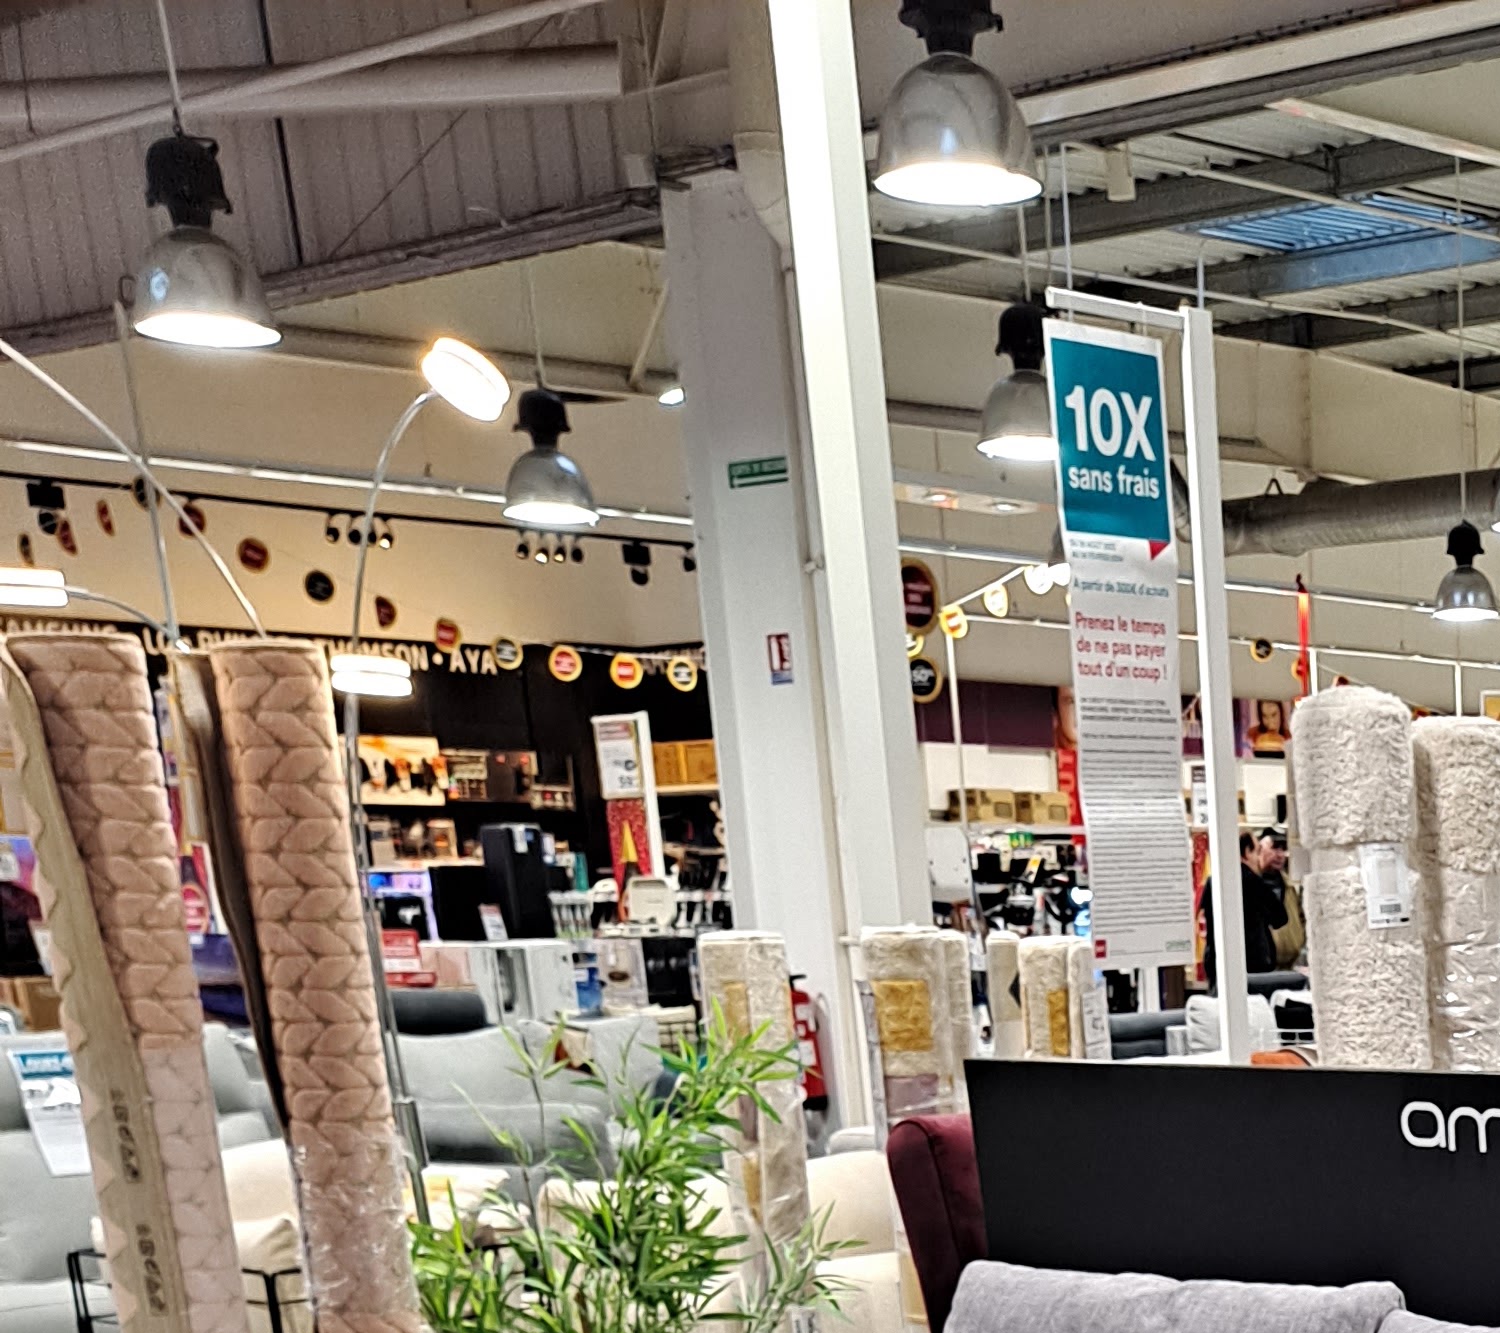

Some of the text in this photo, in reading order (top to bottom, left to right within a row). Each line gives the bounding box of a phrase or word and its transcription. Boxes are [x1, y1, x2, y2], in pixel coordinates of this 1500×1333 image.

[1064, 385, 1157, 462] 10X
[1068, 464, 1160, 500] sans frais
[1075, 611, 1167, 638] Prenez le temps
[1076, 635, 1166, 661] de ne pas payer
[1077, 660, 1103, 677] tout
[1105, 660, 1130, 679] d'un
[1132, 666, 1161, 684] coup
